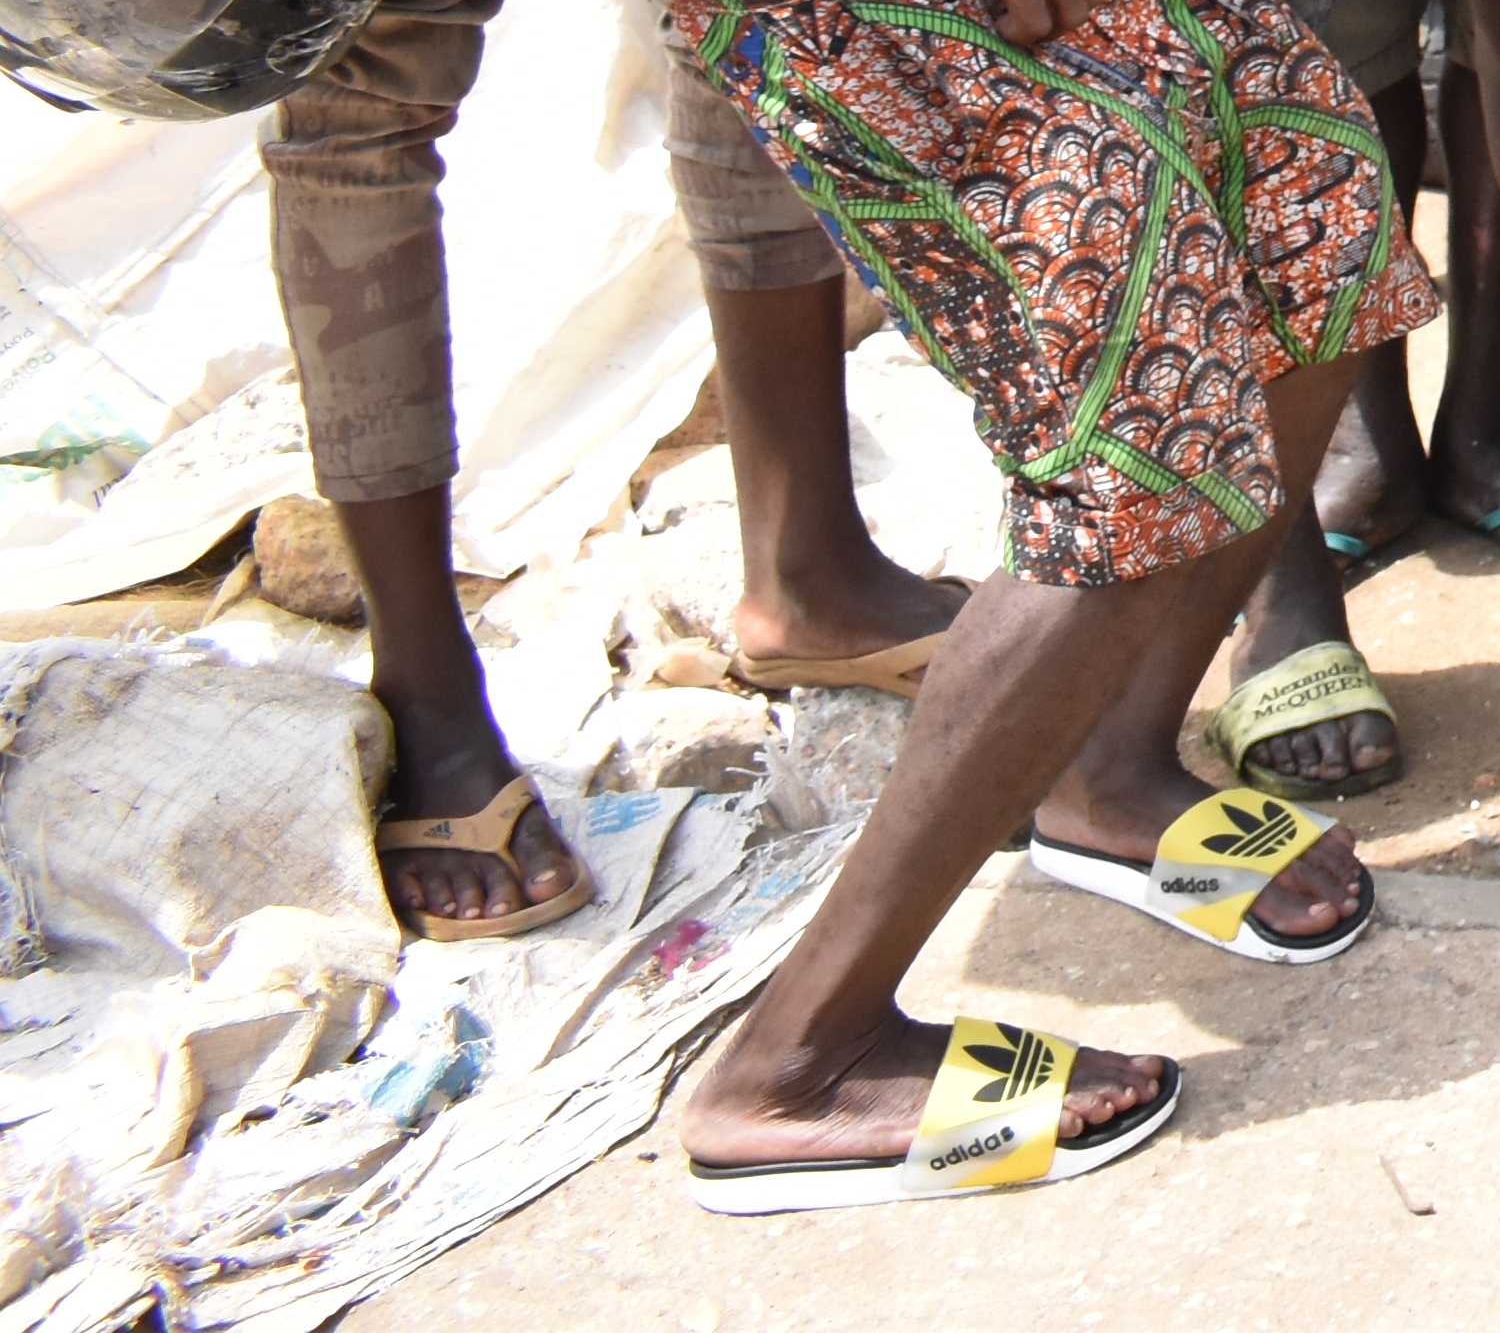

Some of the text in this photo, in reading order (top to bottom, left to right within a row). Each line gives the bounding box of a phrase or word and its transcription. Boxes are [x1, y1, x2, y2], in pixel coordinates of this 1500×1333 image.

[1254, 676, 1371, 721] McQUEEN
[1258, 662, 1361, 706] Alexander
[1161, 873, 1220, 895] adidas
[929, 1123, 1016, 1173] adidas
